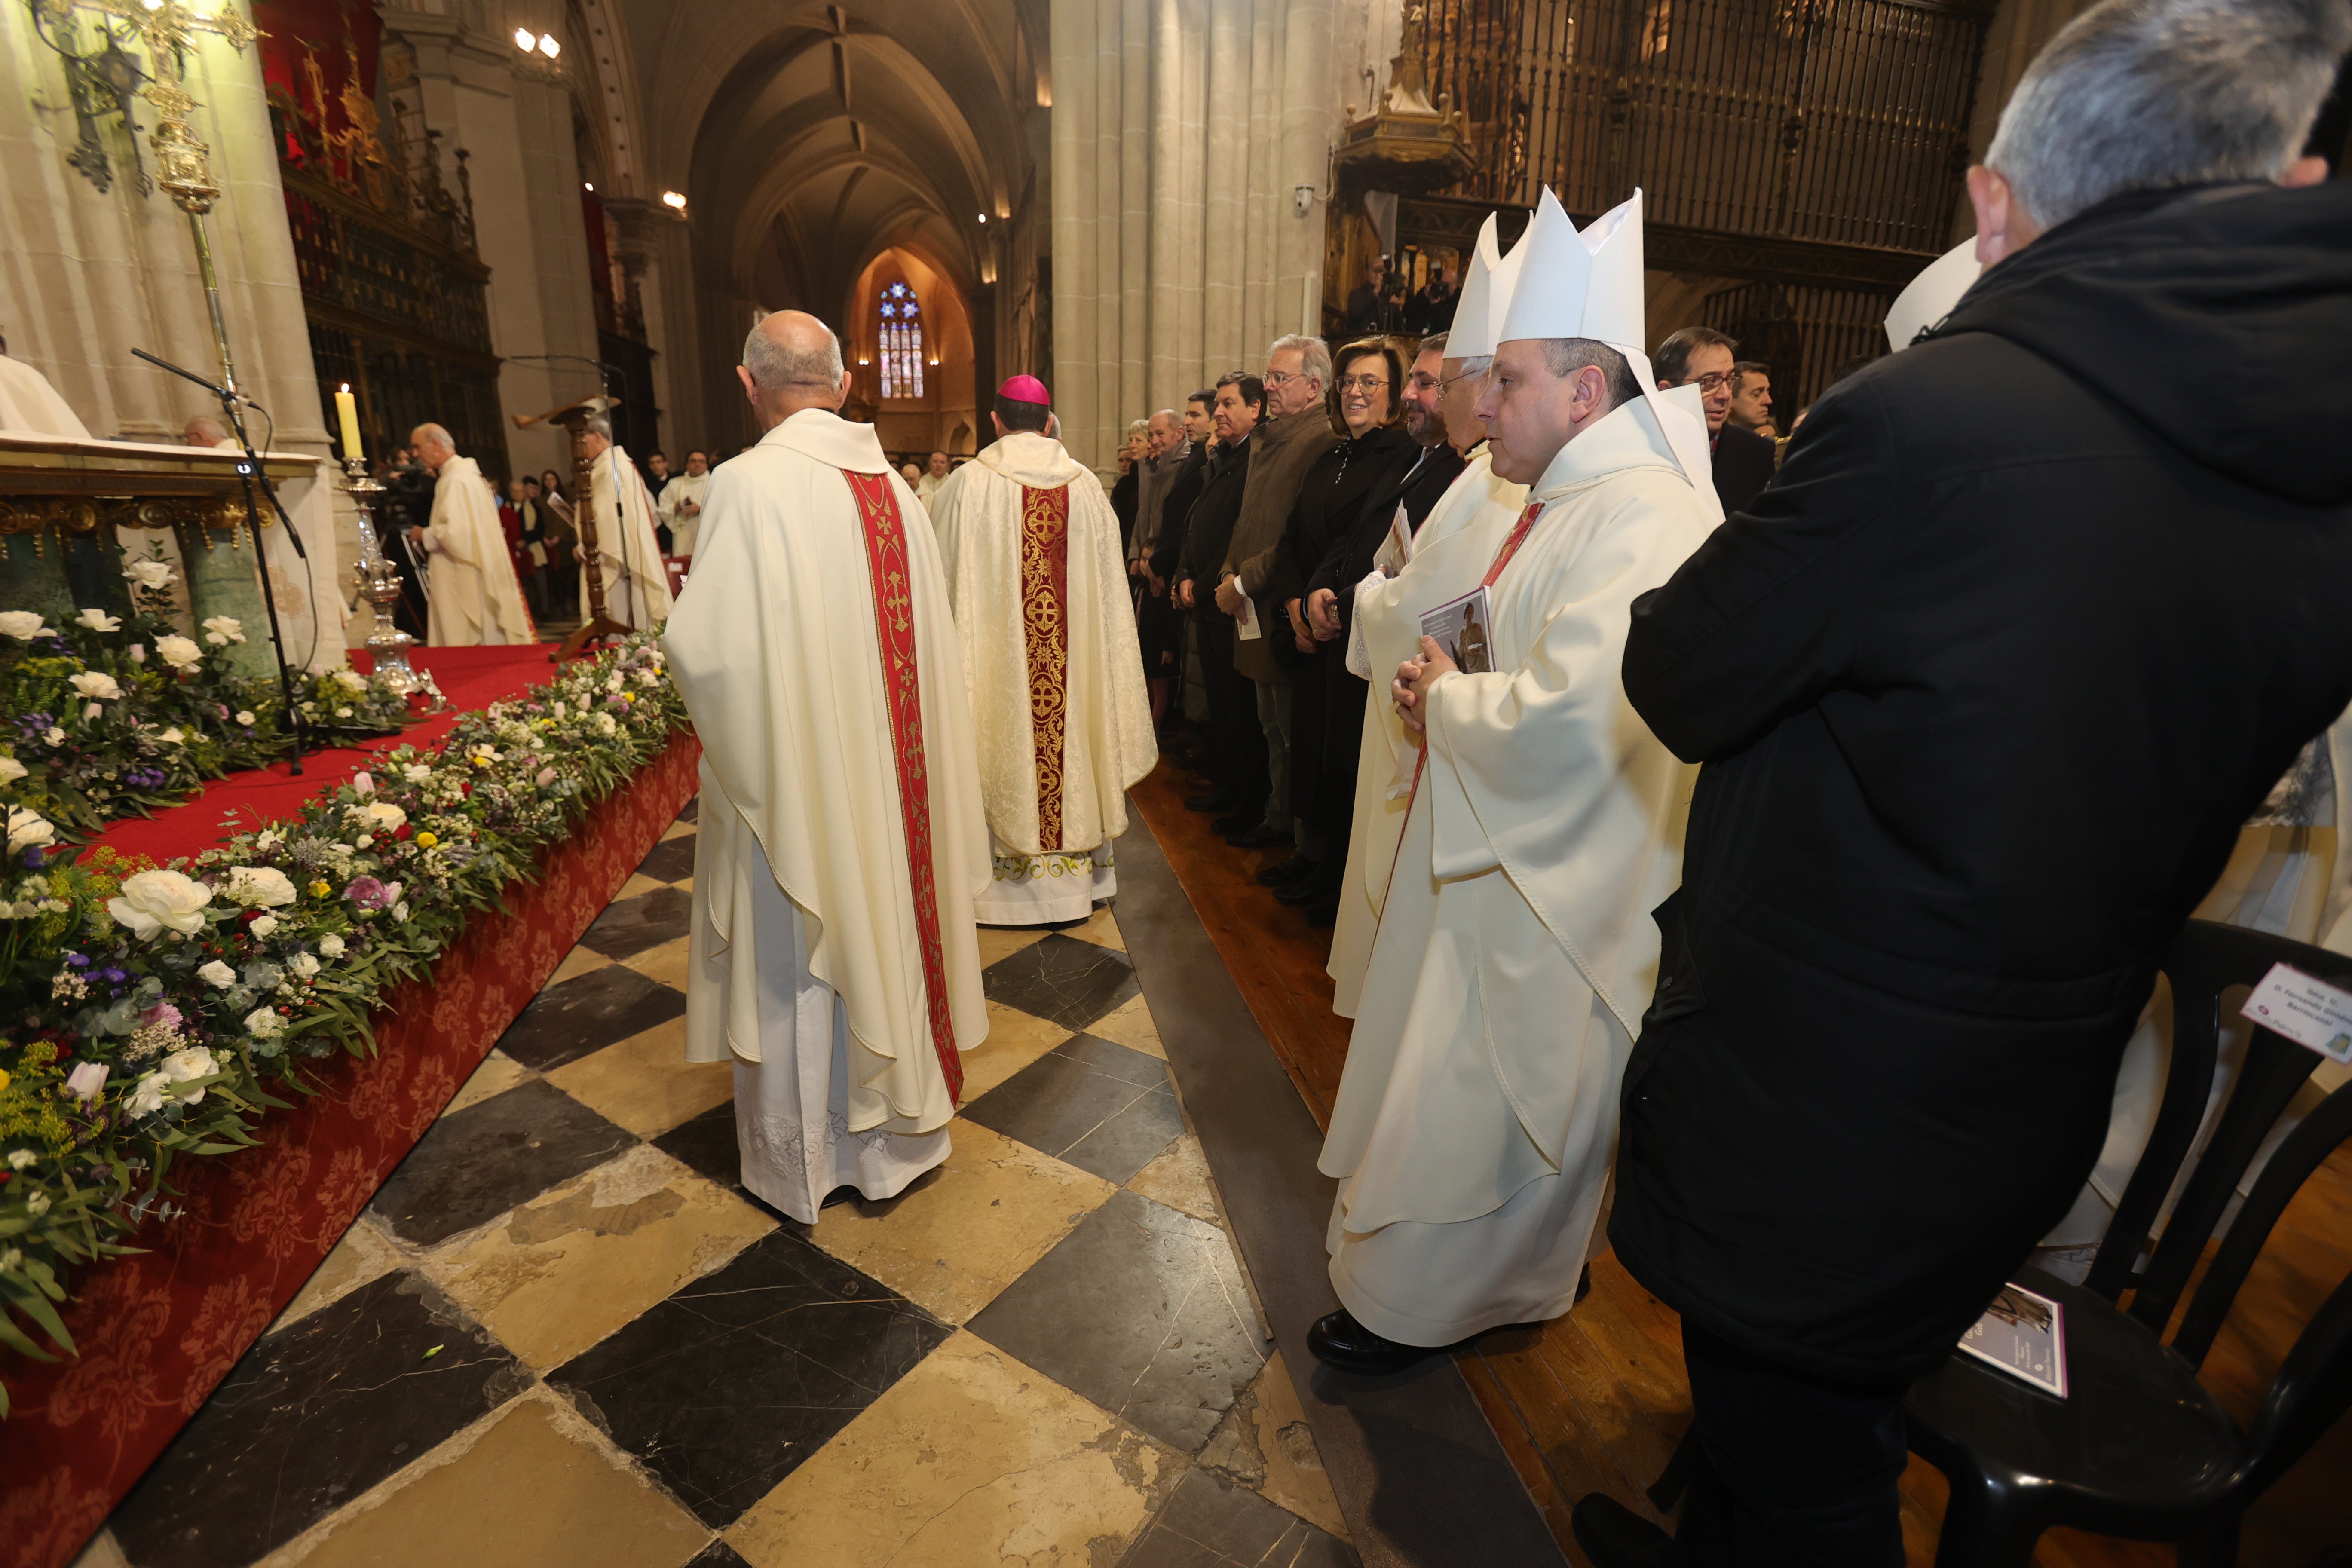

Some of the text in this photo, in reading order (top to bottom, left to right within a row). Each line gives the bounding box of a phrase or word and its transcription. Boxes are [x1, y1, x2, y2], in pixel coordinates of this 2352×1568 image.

[2273, 984, 2282, 992] D.
[2284, 989, 2322, 1010] Fernando
[2287, 1001, 2333, 1026] Barriocanal
